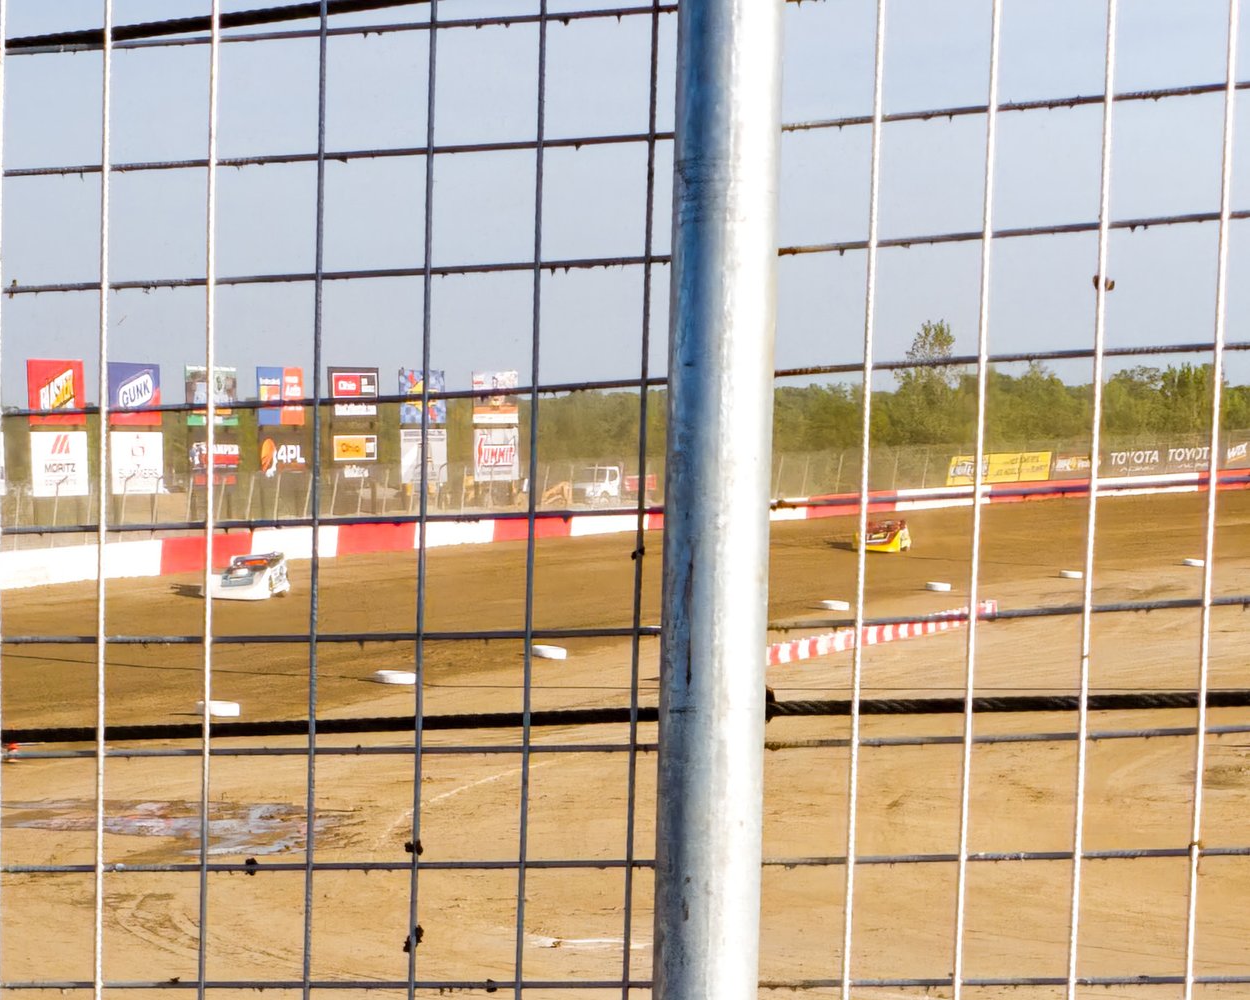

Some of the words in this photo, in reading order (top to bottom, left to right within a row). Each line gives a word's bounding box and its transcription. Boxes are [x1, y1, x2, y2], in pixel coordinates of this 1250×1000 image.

[121, 379, 151, 406] GUNK
[277, 444, 306, 464] 4PL
[478, 436, 515, 467] SUMMIT
[1110, 450, 1159, 465] TOYOTA
[1168, 446, 1212, 461] TOYOT
